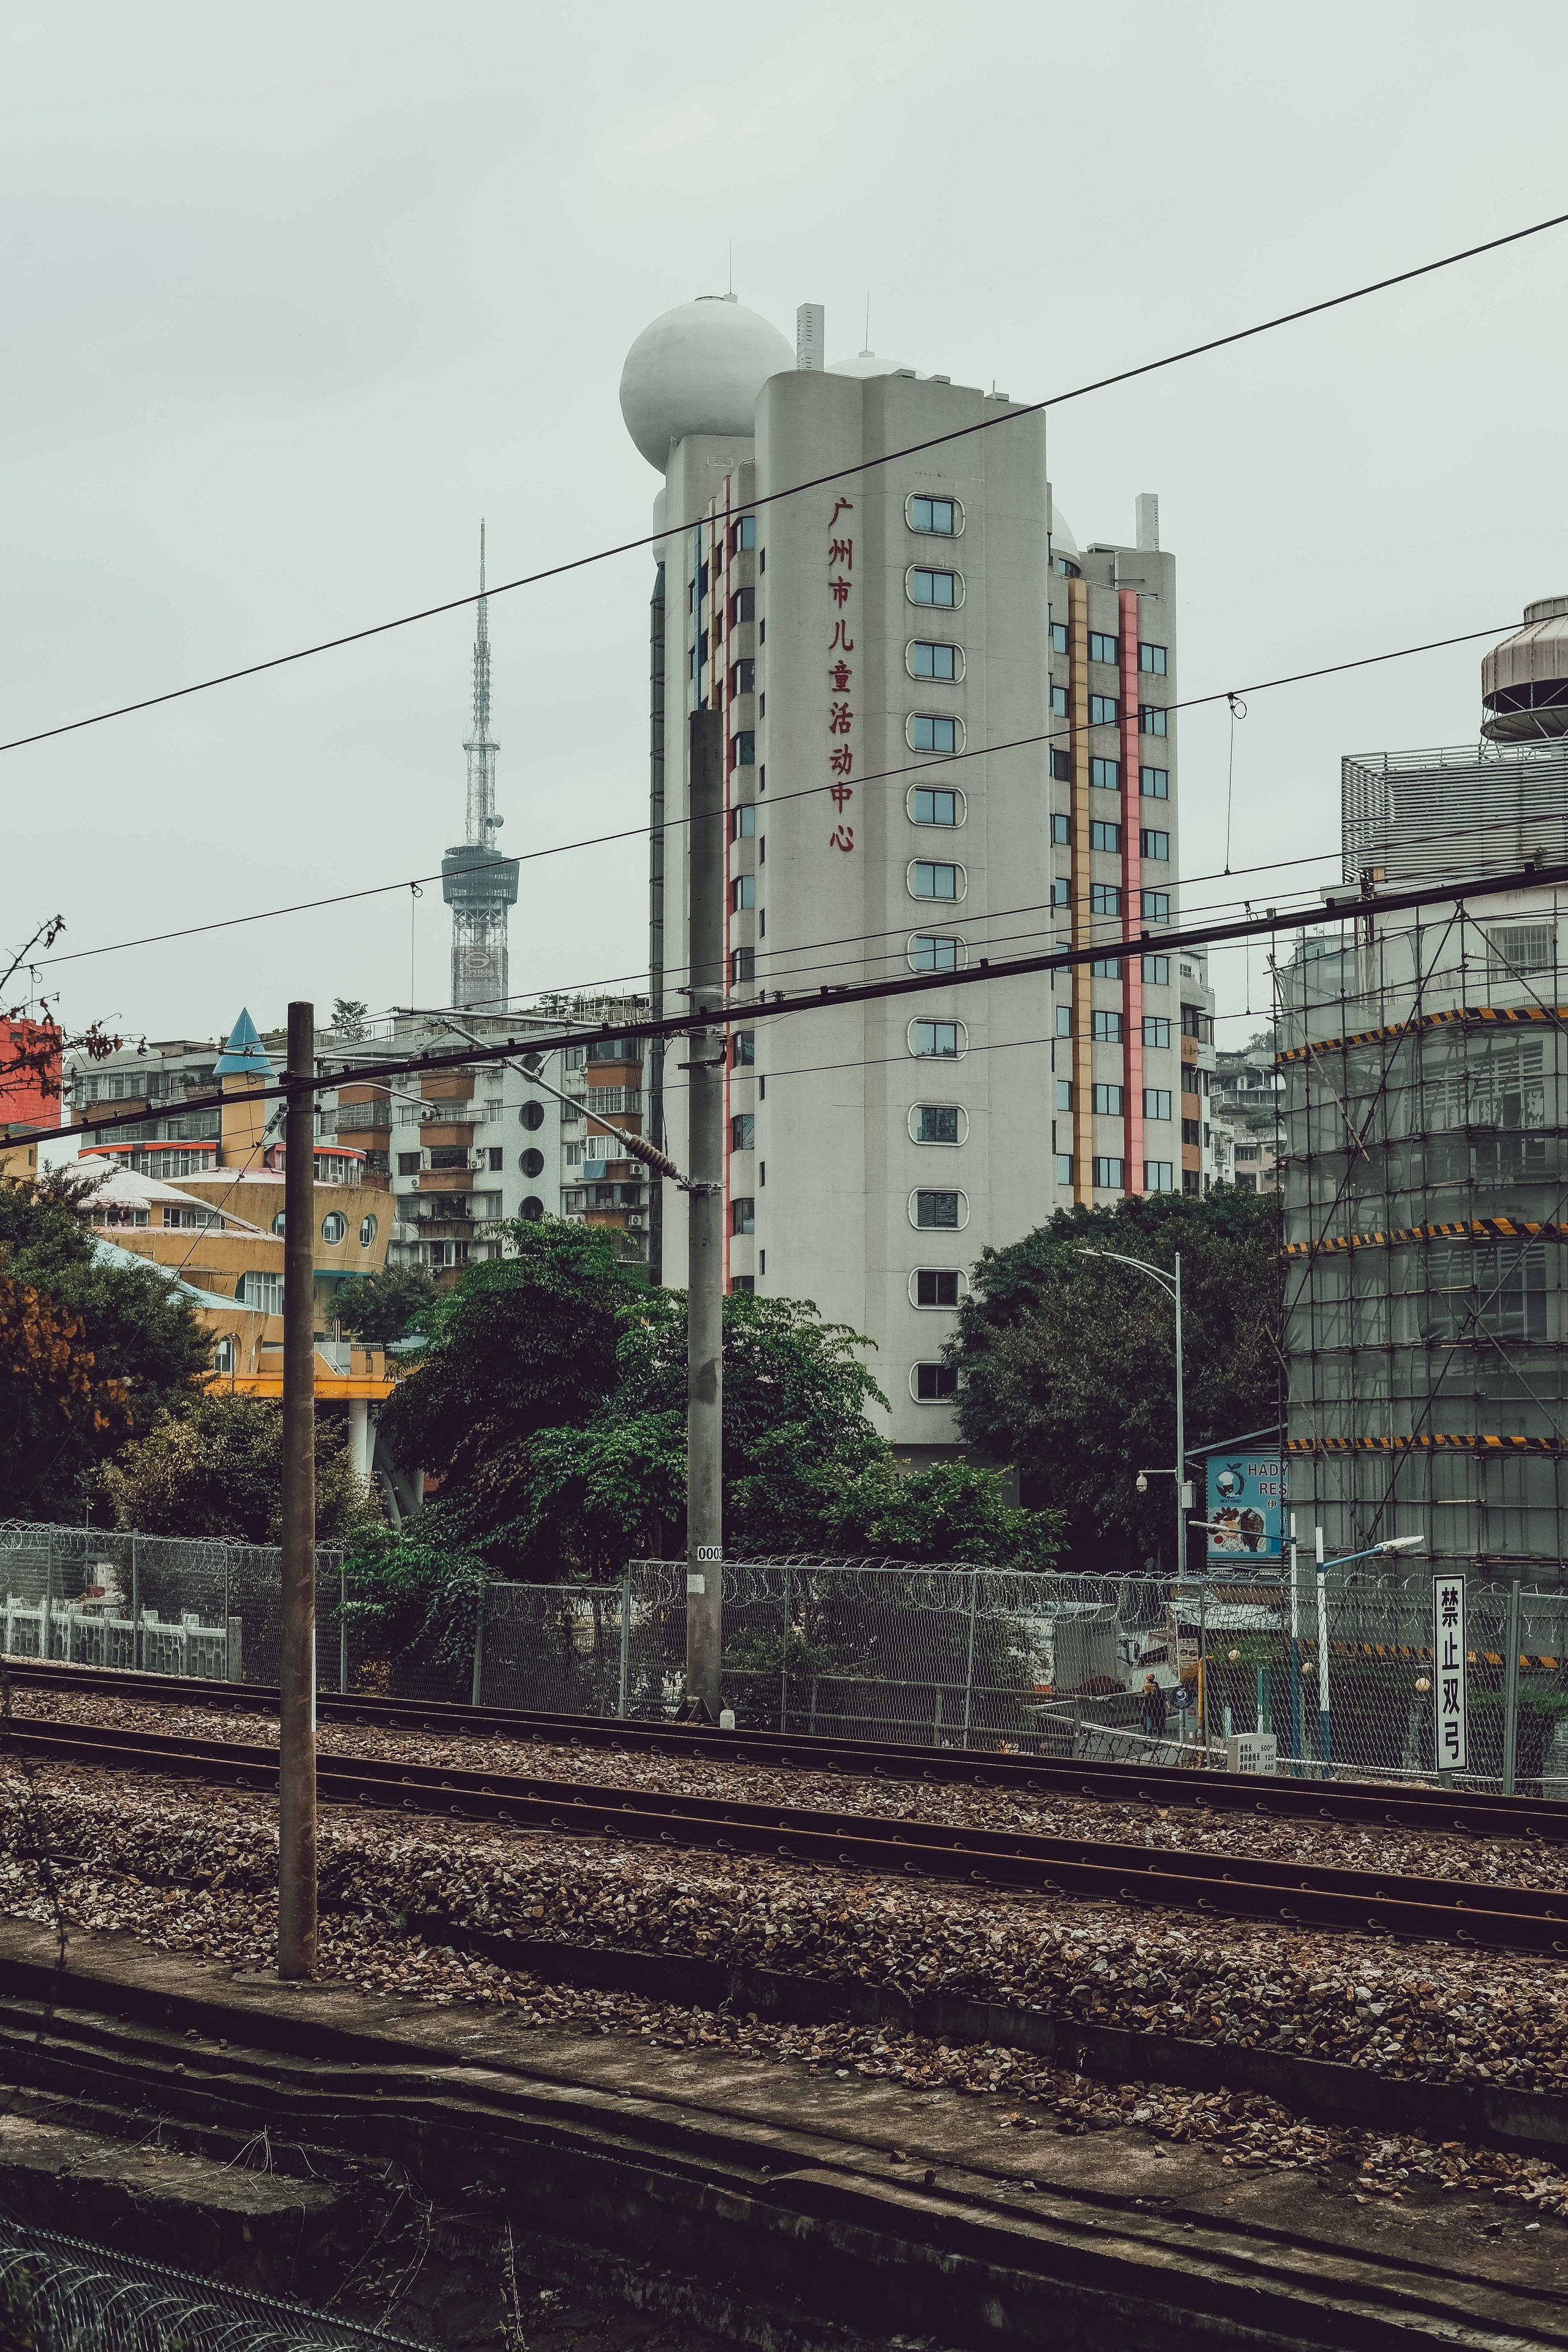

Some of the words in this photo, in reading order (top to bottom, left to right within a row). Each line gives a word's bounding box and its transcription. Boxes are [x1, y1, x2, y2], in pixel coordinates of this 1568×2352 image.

[829, 497, 854, 852] 广州市儿童活动中心
[1240, 1744, 1253, 1752] 曲线长
[1441, 1586, 1460, 1760] 禁止双弓
